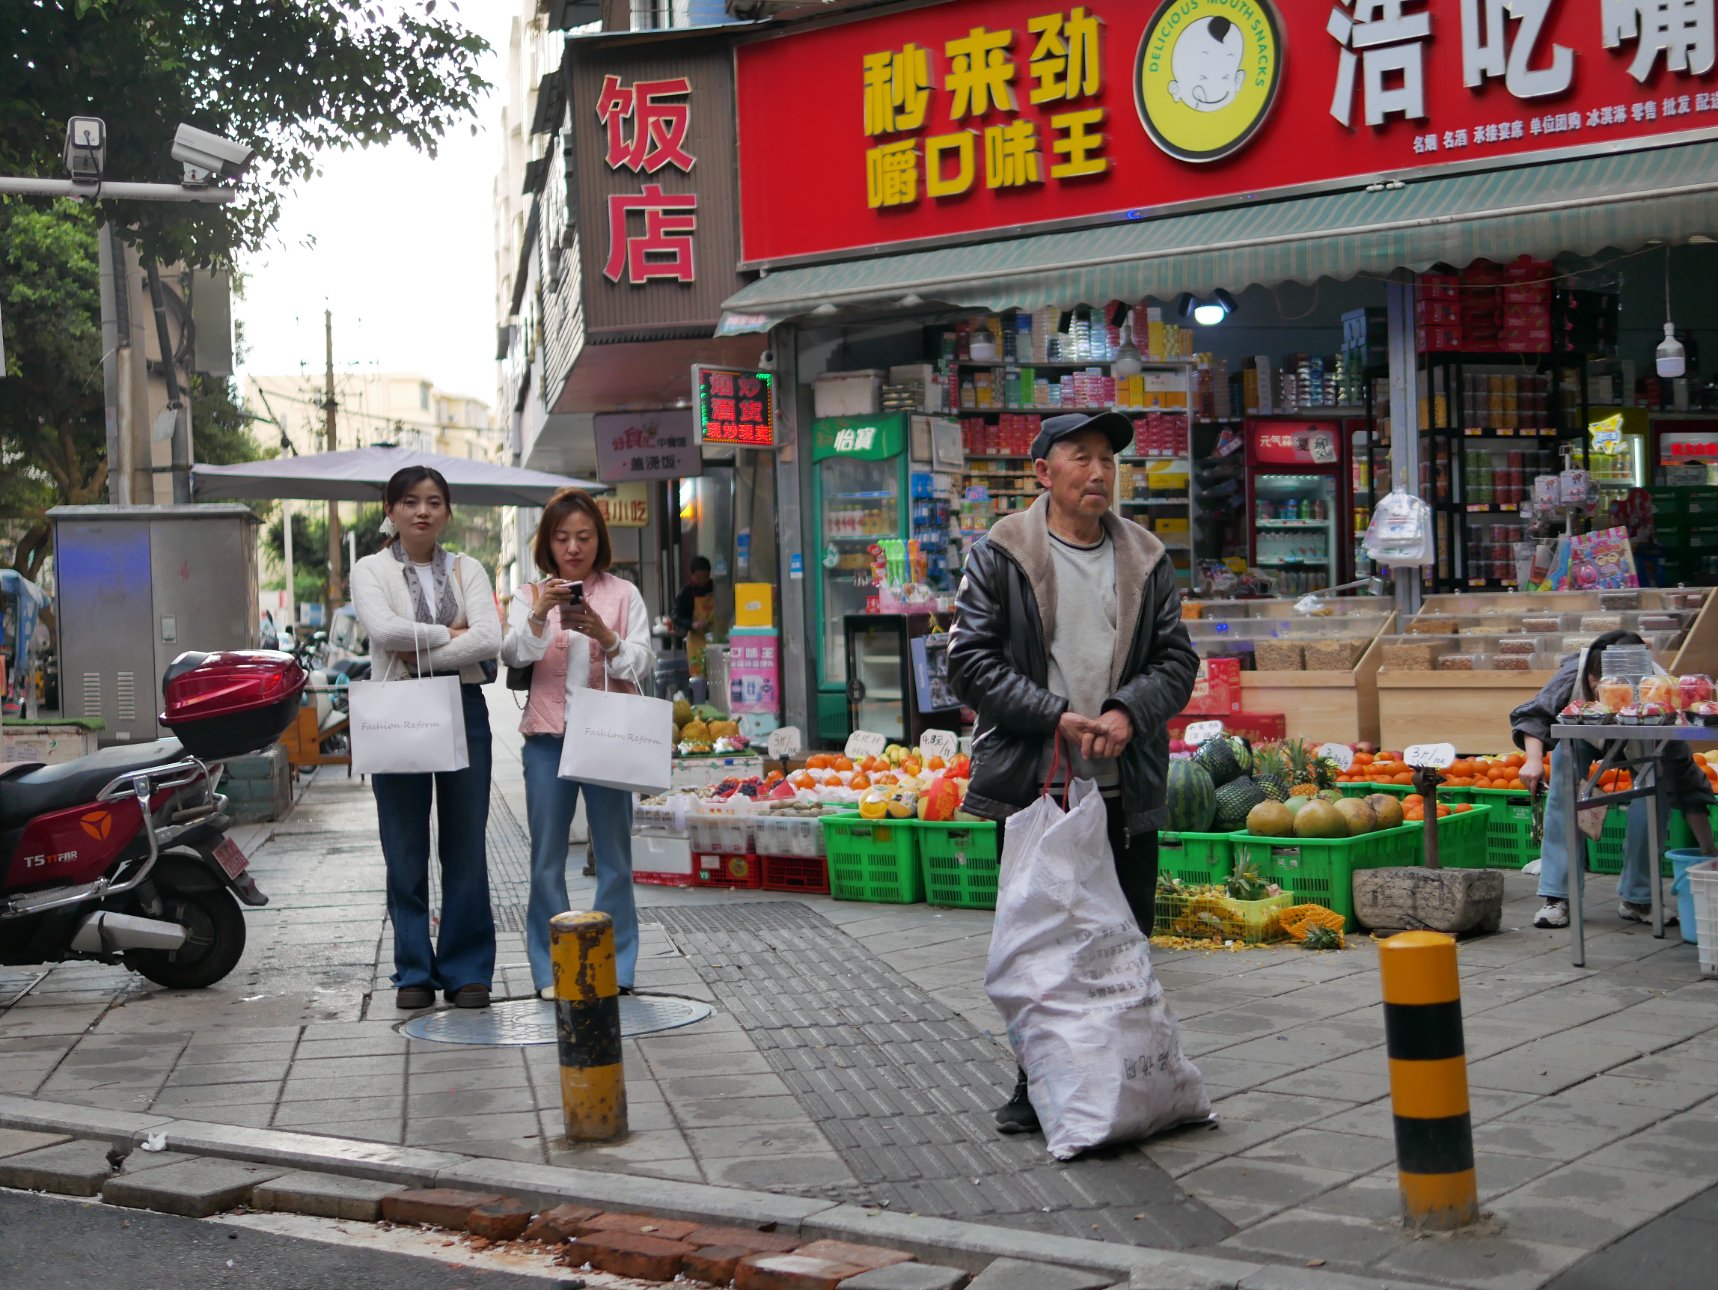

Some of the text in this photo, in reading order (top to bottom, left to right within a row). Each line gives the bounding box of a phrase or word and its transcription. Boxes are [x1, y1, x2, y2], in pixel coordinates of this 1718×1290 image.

[1149, 0, 1198, 72] DELICIOUS
[1251, 19, 1268, 87] SNACKS
[863, 6, 1103, 136] 秒来劲
[1413, 134, 1437, 154] 名烟
[1443, 129, 1468, 149] 名酒
[1473, 120, 1524, 144] 承接宴席
[1530, 112, 1581, 135] 单位团购
[1586, 104, 1627, 127] 冰淇淋
[1631, 100, 1656, 121] 零售
[1662, 96, 1690, 117] 批发
[866, 107, 1108, 208] 嚼口味王
[596, 74, 697, 284] 饭店
[707, 421, 769, 441] 现炒现卖
[834, 427, 876, 451] 怡寶
[631, 454, 676, 471] 盖浇饭
[361, 720, 440, 731] Fashion Reform
[585, 727, 662, 745] Fashion Reform
[24, 854, 45, 868] T5
